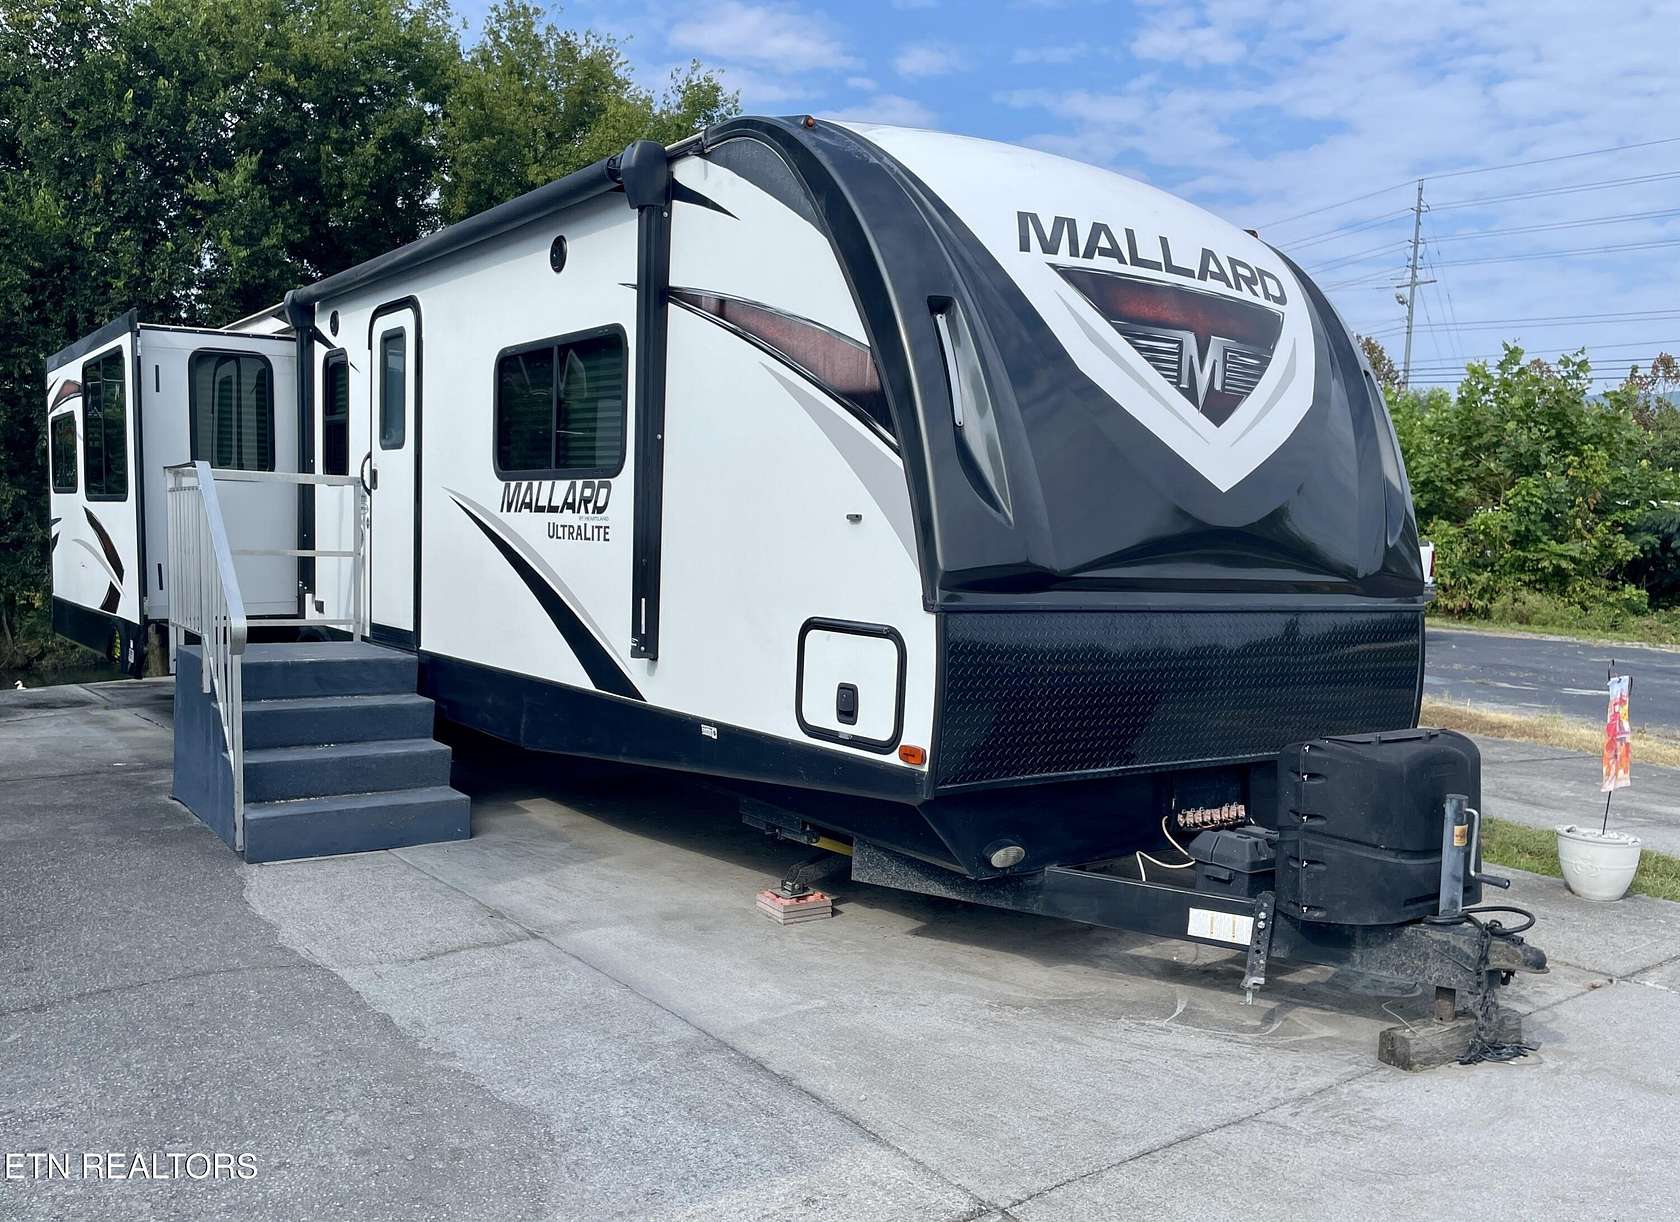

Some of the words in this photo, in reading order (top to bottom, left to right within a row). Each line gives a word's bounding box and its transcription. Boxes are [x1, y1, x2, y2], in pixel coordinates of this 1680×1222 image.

[1016, 210, 1288, 306] MALLARD
[1179, 330, 1223, 412] M
[500, 480, 612, 515] MALLARD
